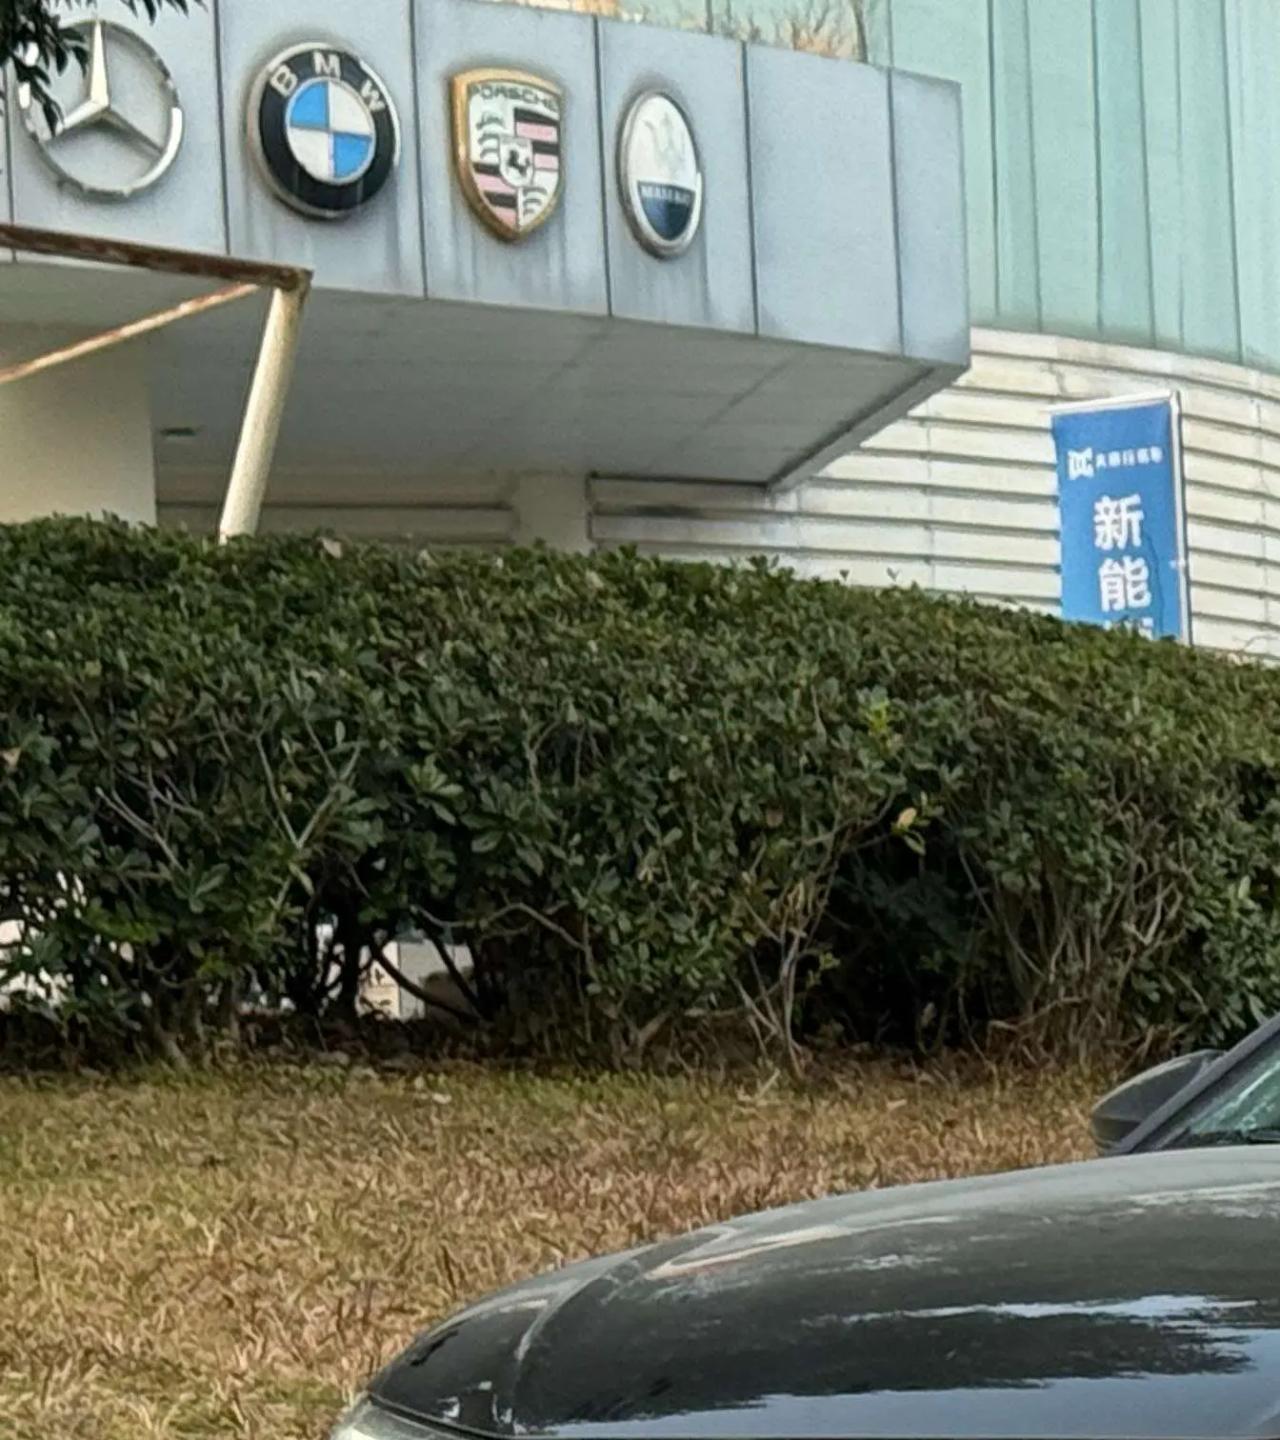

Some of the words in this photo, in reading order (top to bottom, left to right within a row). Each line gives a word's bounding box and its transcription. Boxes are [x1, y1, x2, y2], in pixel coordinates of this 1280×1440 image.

[269, 52, 386, 111] BMW
[471, 83, 560, 114] PORSCHE
[1094, 494, 1155, 637] 新能
